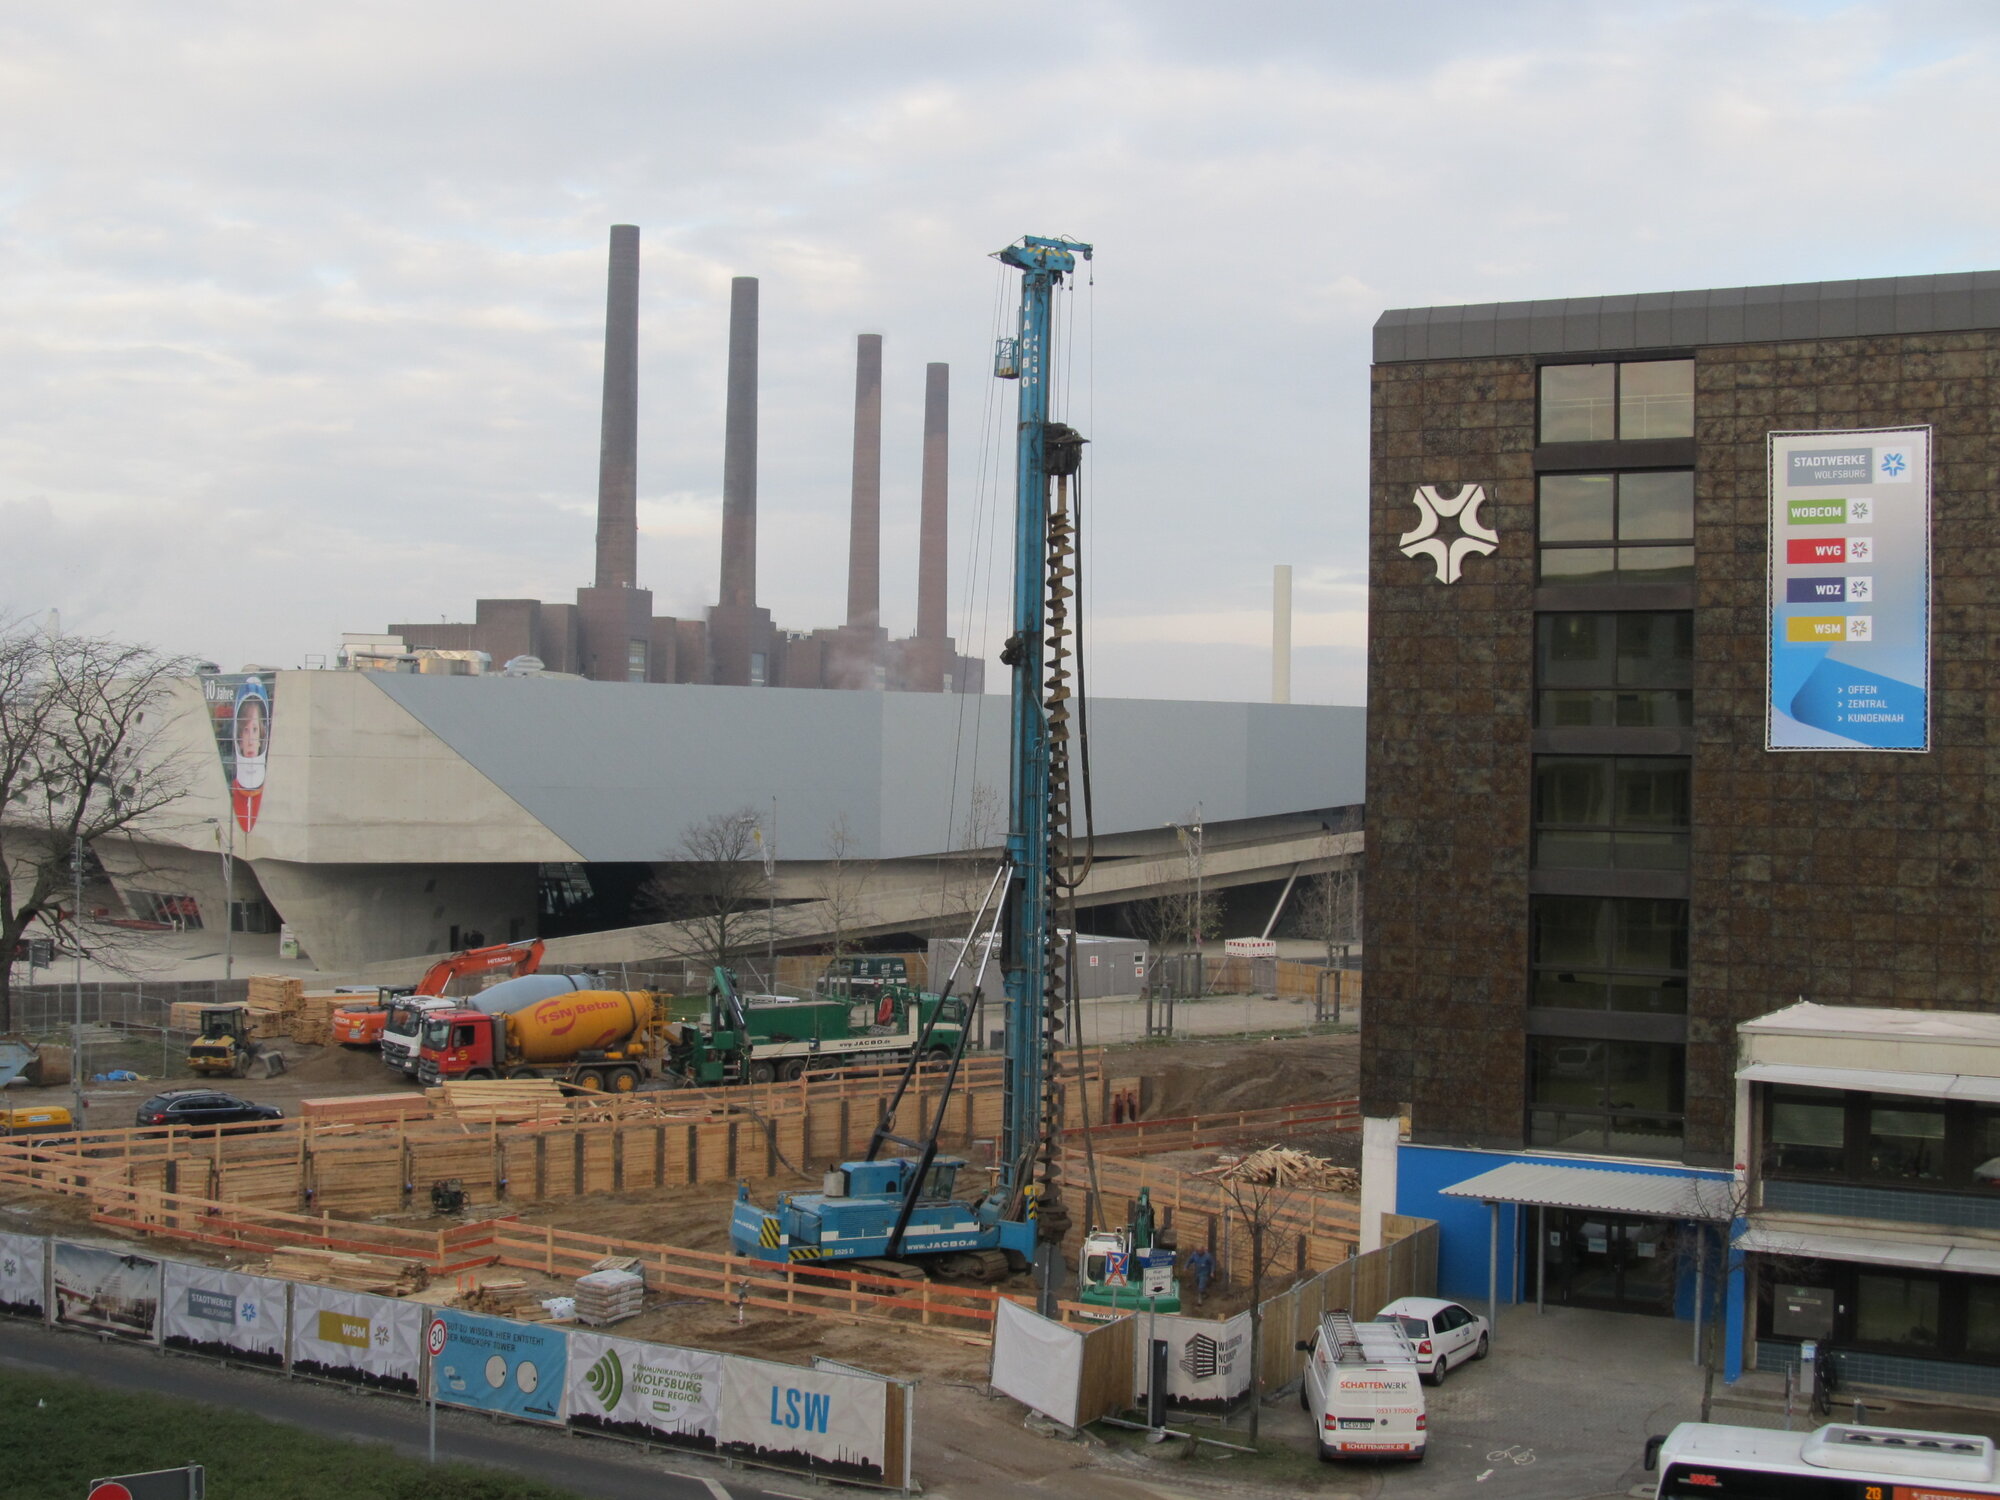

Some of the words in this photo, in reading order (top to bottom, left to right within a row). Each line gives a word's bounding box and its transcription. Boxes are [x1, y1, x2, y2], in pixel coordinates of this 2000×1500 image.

[1022, 300, 1031, 388] JACBO
[1794, 454, 1866, 467] STADTWERKE
[1814, 468, 1866, 480] WOLFSBURG
[1791, 506, 1842, 518] WOBCOM
[1815, 545, 1841, 556] WVG
[1815, 584, 1841, 596] WDZ
[1814, 623, 1841, 635] WSM
[205, 679, 215, 700] 10
[216, 687, 234, 700] Jahre
[1847, 685, 1878, 695] OFFEN
[1847, 699, 1888, 709] ZENTRAL
[1847, 713, 1904, 723] KUNDENNAH
[487, 955, 512, 965] HITACHI
[537, 1007, 573, 1024] TSN
[575, 1000, 619, 1014] Beton
[906, 1238, 978, 1251] www.JACBO.de
[191, 1293, 233, 1309] STADTWERKE
[342, 1323, 367, 1338] WSM
[431, 1328, 443, 1347] 30
[496, 1330, 512, 1340] HIER
[513, 1333, 544, 1346] ENTSTEHT
[632, 1363, 689, 1379] KOMMUNIKATION
[632, 1372, 702, 1394] WOLFSBURG
[631, 1384, 649, 1395] UND
[652, 1388, 665, 1398] DIE
[667, 1391, 702, 1403] REGION
[771, 1385, 830, 1434] LSW
[1865, 1487, 1882, 1500] 213
